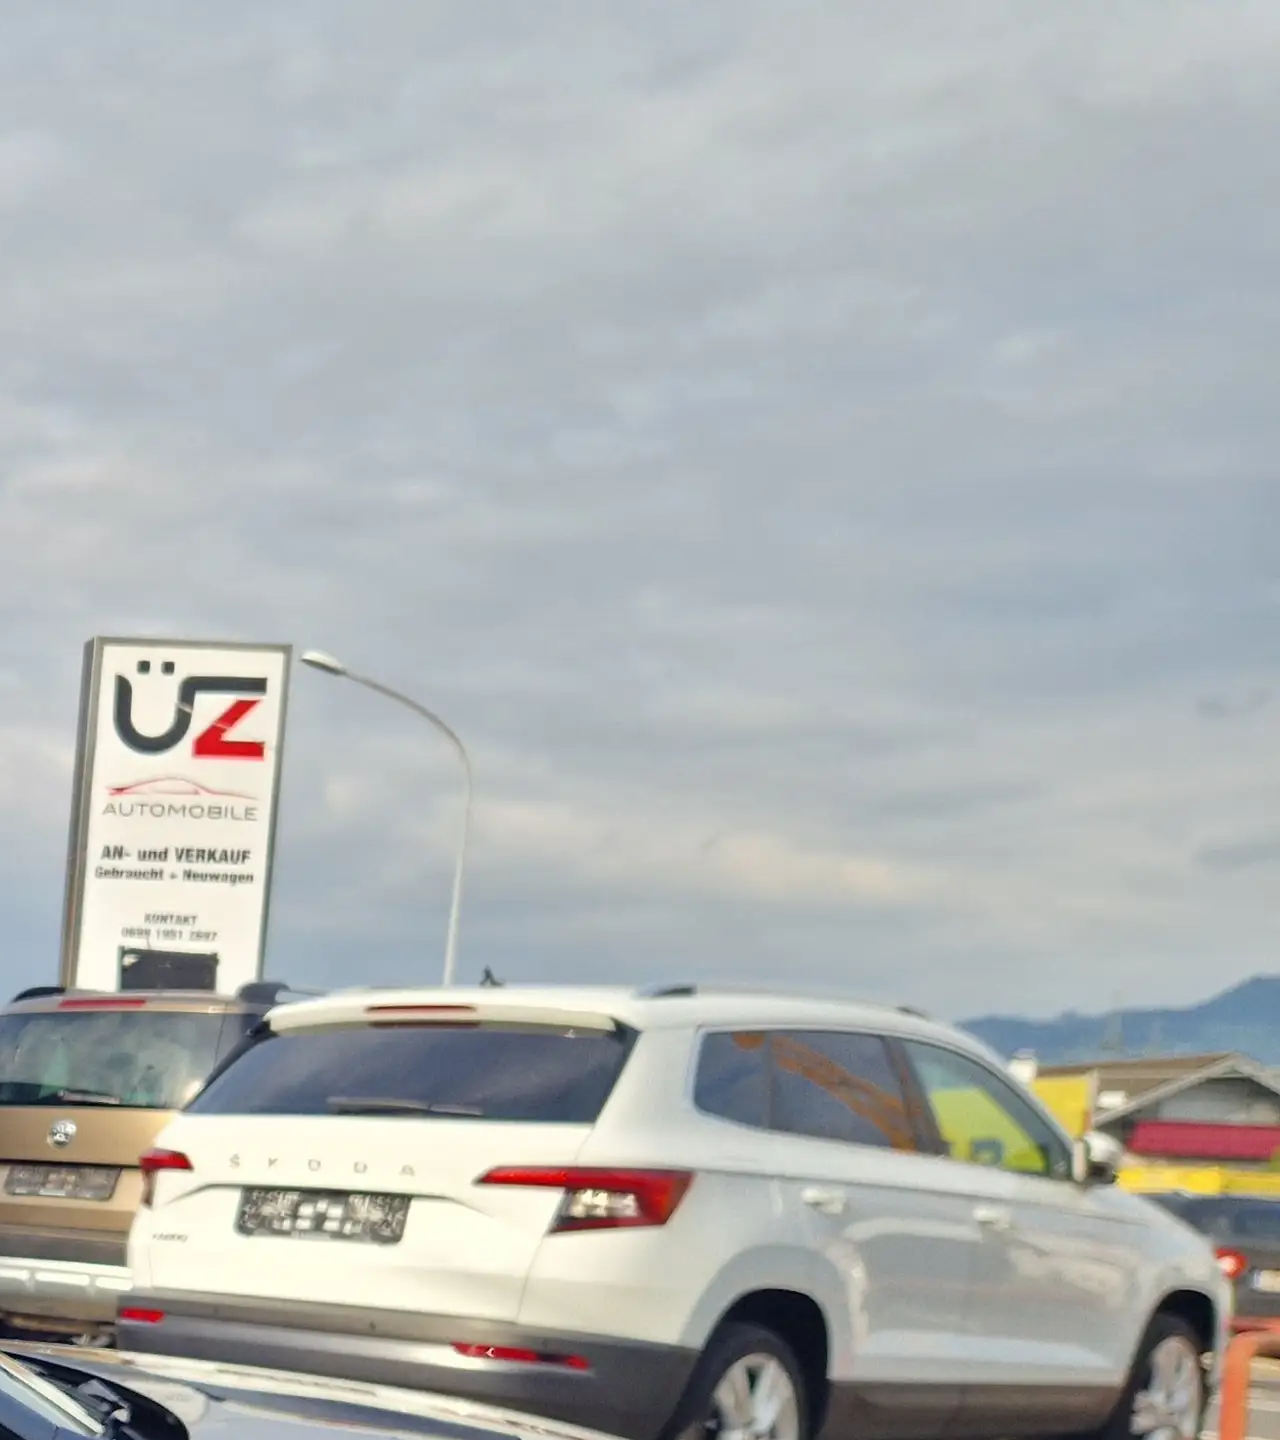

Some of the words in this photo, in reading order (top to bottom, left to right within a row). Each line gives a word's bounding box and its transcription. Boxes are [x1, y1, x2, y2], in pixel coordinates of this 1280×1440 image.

[113, 659, 268, 761] ÜZ
[102, 802, 259, 821] AUTOMOBILE
[100, 845, 132, 861] AN-
[137, 847, 169, 862] und
[174, 847, 252, 865] VERKAUF
[95, 866, 164, 882] Gebraucht
[182, 869, 255, 887] Neuwagen
